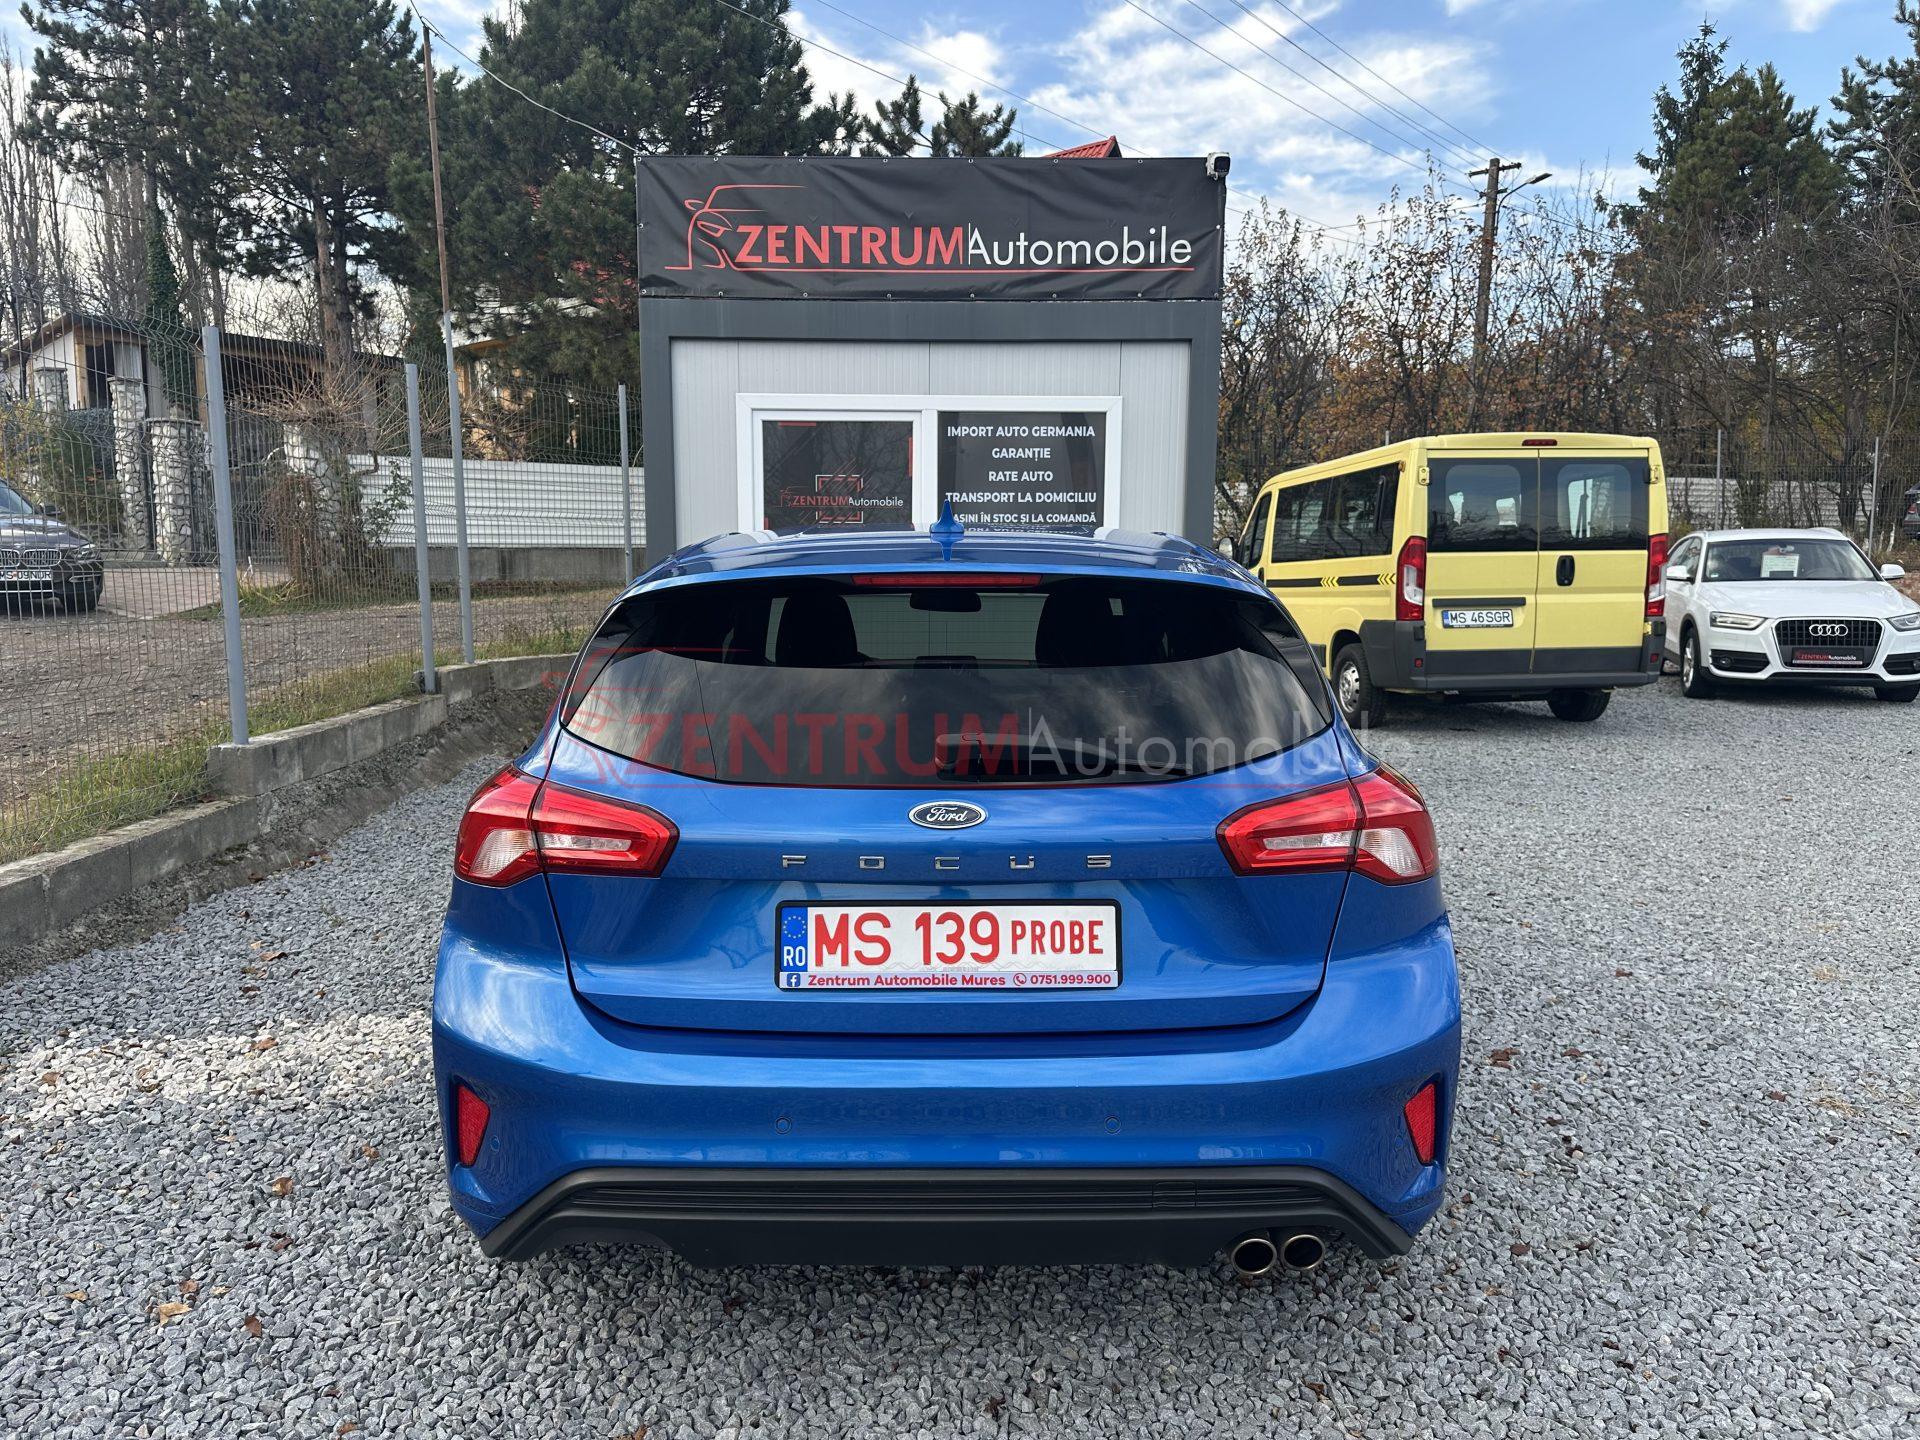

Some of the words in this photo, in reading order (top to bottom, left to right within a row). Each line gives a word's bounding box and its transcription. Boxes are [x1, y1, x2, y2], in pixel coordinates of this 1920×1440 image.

[734, 225, 964, 264] ZENTRUM
[969, 225, 1192, 266] Automobile
[947, 426, 993, 437] IMPORT
[995, 426, 1029, 437] AUTO
[1031, 426, 1095, 437] GERMANIA
[991, 448, 1051, 461] GARANȚIE
[988, 471, 1018, 482] RATE
[1020, 471, 1053, 482] AUTO
[791, 495, 848, 506] ZENTRUM
[848, 496, 904, 507] Automobile
[945, 492, 1015, 503] TRANSPORT
[1018, 492, 1033, 503] LA
[1036, 492, 1097, 503] DOMICILIU
[980, 511, 992, 523] ÎN
[993, 513, 1018, 523] STOC
[1031, 513, 1044, 523] LA
[1045, 511, 1096, 523] COMANDĂ
[1449, 612, 1467, 623] MS
[926, 806, 968, 822] Ford
[782, 855, 1112, 869] FOCUS
[783, 945, 806, 967] RO
[815, 912, 892, 967] MS
[915, 910, 1000, 965] 139
[1011, 919, 1104, 955] PROBE
[808, 974, 870, 986] Zentrum
[874, 974, 957, 986] Automobile
[961, 974, 1006, 986] Mures
[1030, 974, 1111, 985] 0751.999.900
